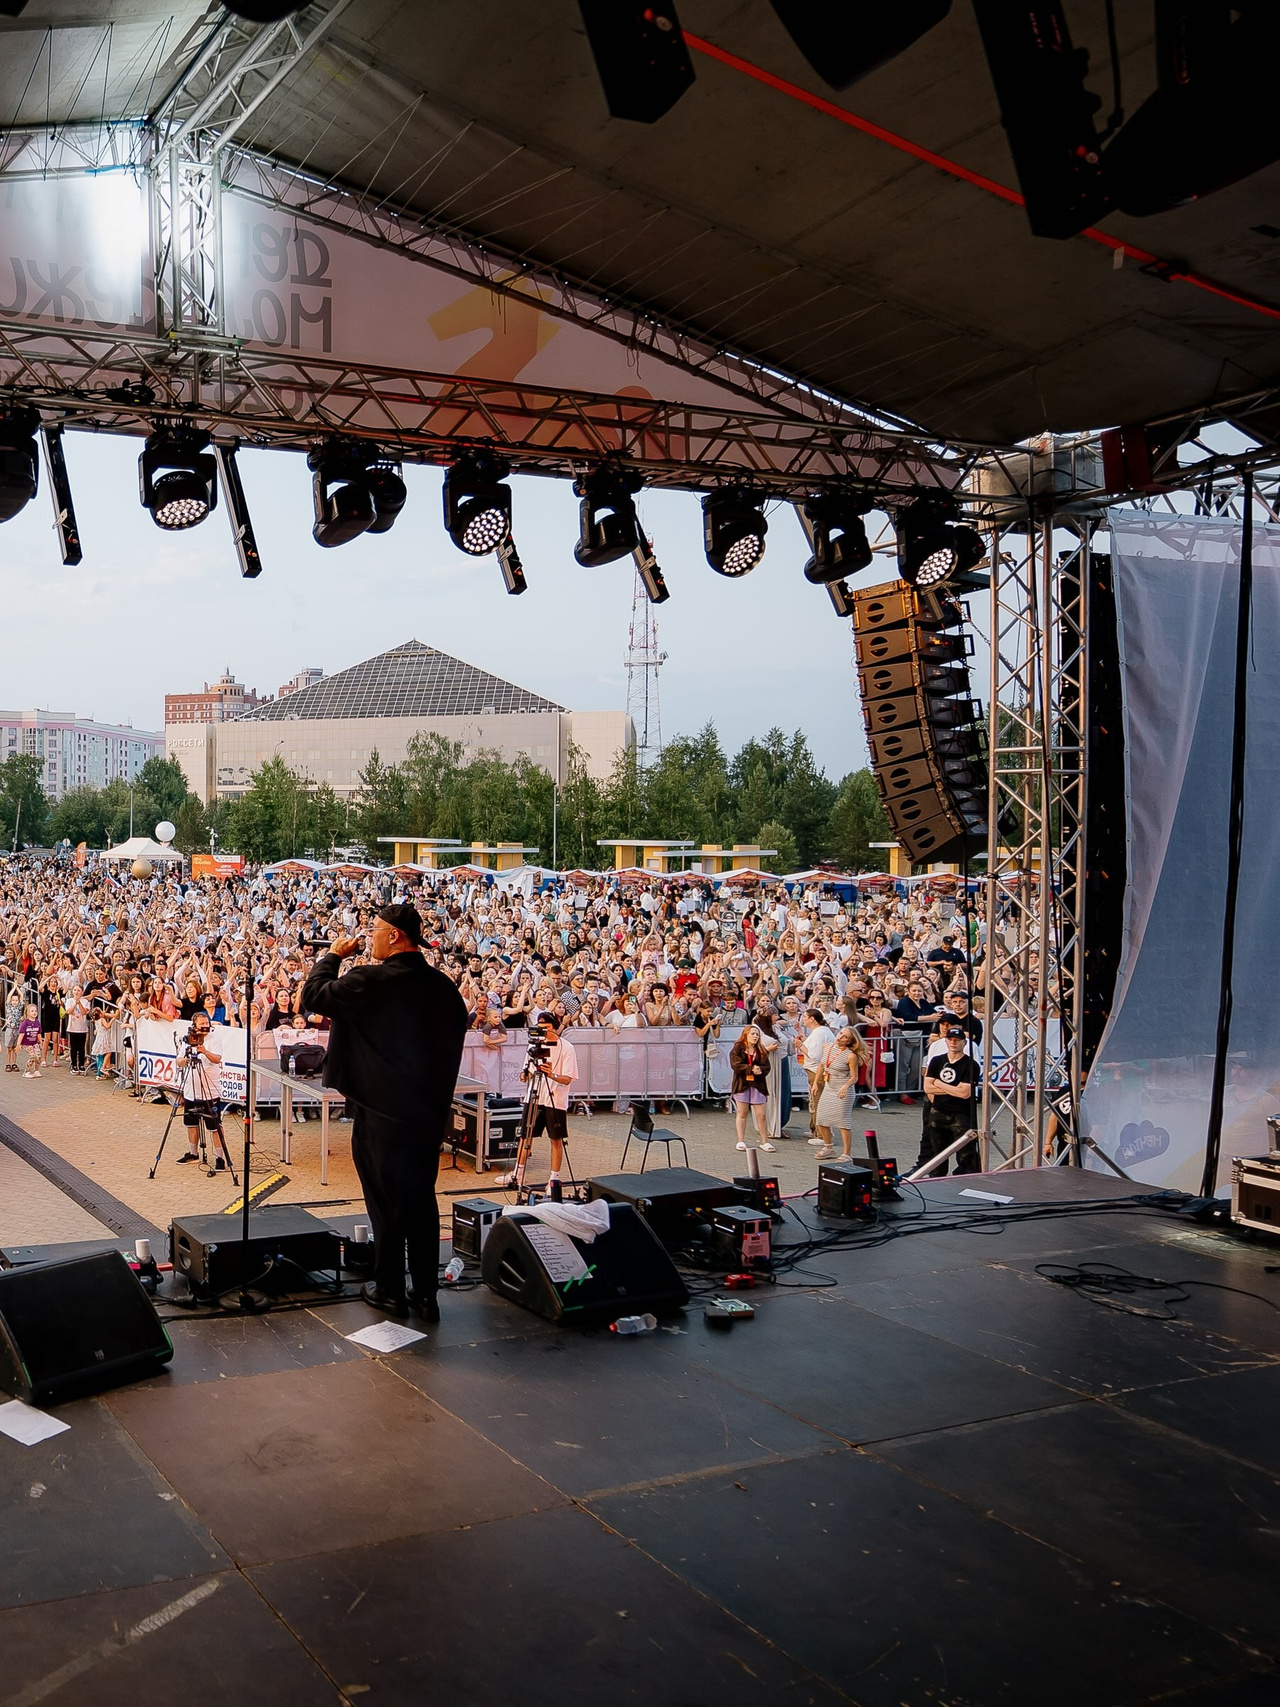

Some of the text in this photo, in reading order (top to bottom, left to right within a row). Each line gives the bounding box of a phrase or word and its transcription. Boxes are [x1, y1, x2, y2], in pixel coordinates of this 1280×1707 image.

[139, 1056, 174, 1081] 2026
[220, 1070, 247, 1081] ИНСТВА
[222, 1090, 238, 1100] СИИ
